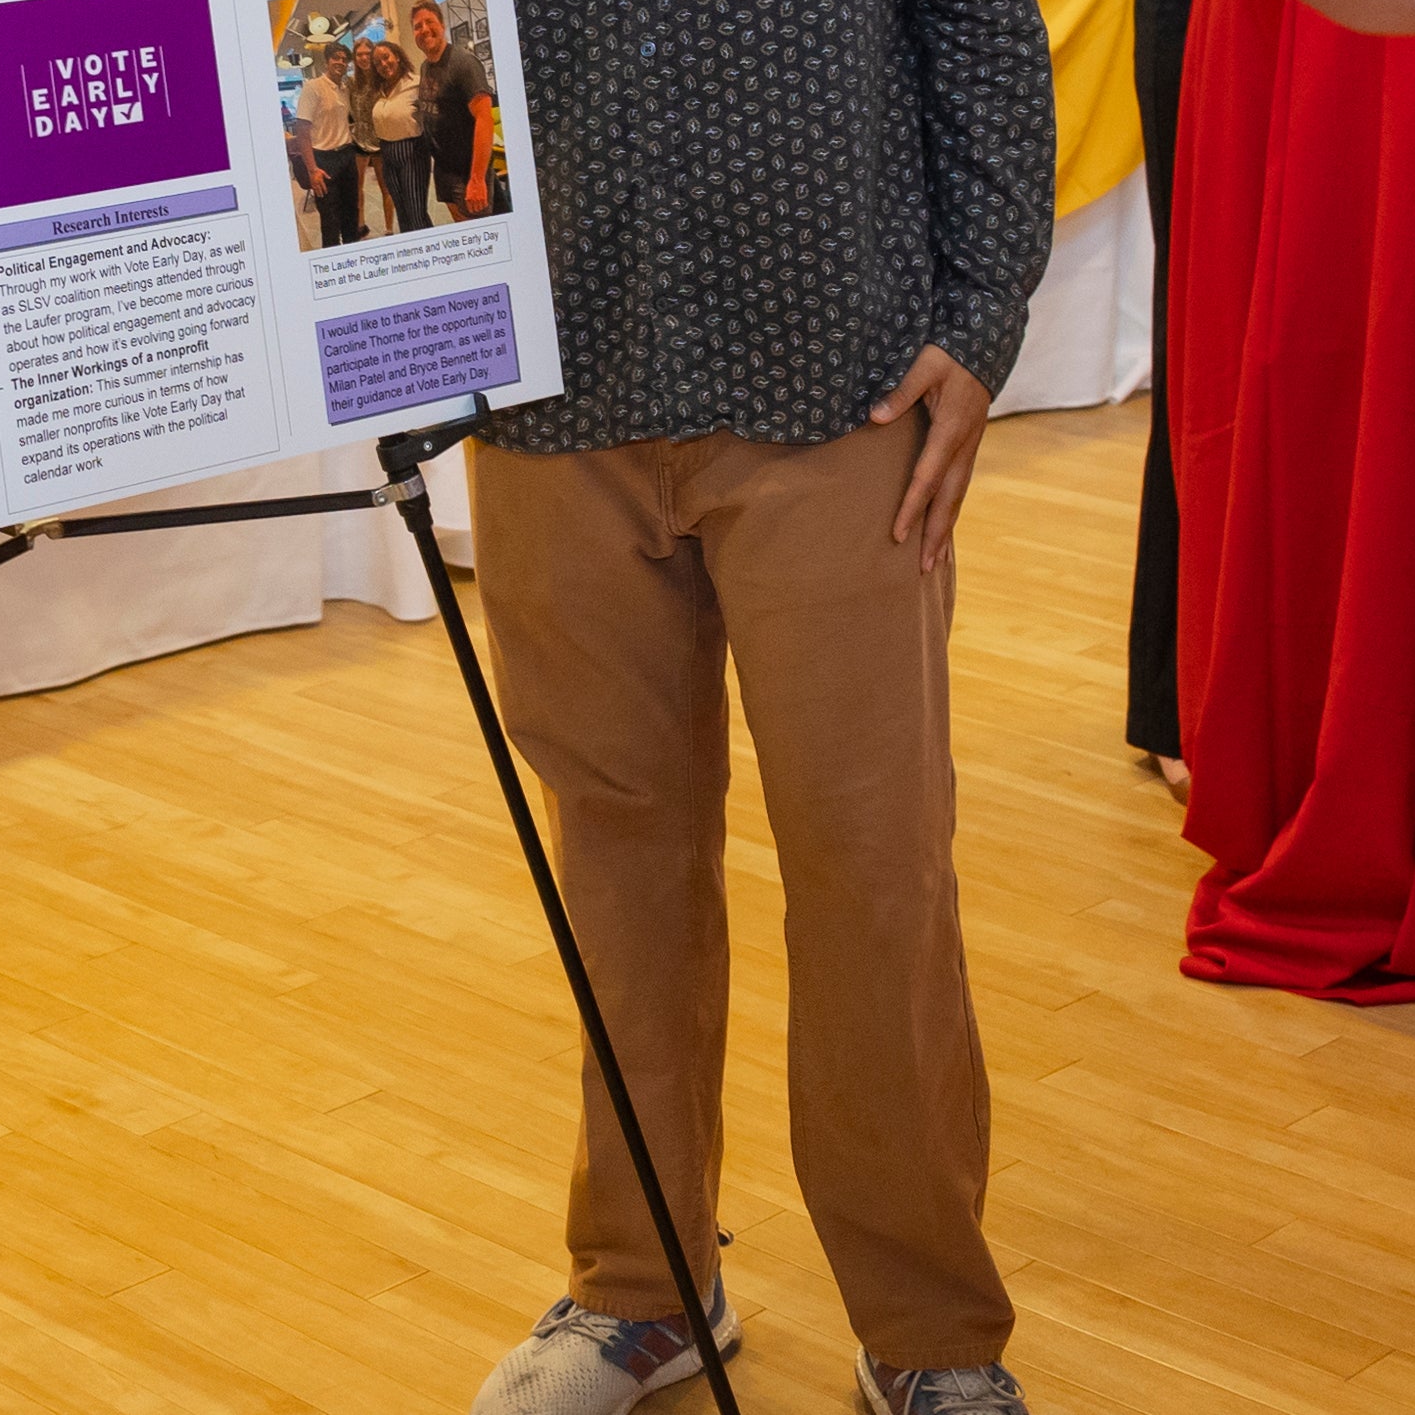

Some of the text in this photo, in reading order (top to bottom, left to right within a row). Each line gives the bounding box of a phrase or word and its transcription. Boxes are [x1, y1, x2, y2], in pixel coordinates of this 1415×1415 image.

[55, 46, 157, 79] VOTE
[31, 72, 159, 111] EARLY
[35, 106, 108, 137] DAY
[51, 204, 170, 236] Research Interests
[48, 244, 124, 269] Engagement
[126, 239, 149, 255] and
[150, 230, 211, 251] Advocacy:
[314, 244, 494, 290] team at the Laufer Internship Program Kickoff
[10, 339, 210, 391] The Inner Workings of a nonprofit
[13, 351, 245, 410] organization: This summer internship has
[327, 342, 507, 394] Milan Patel and Bryce Bennett for all
